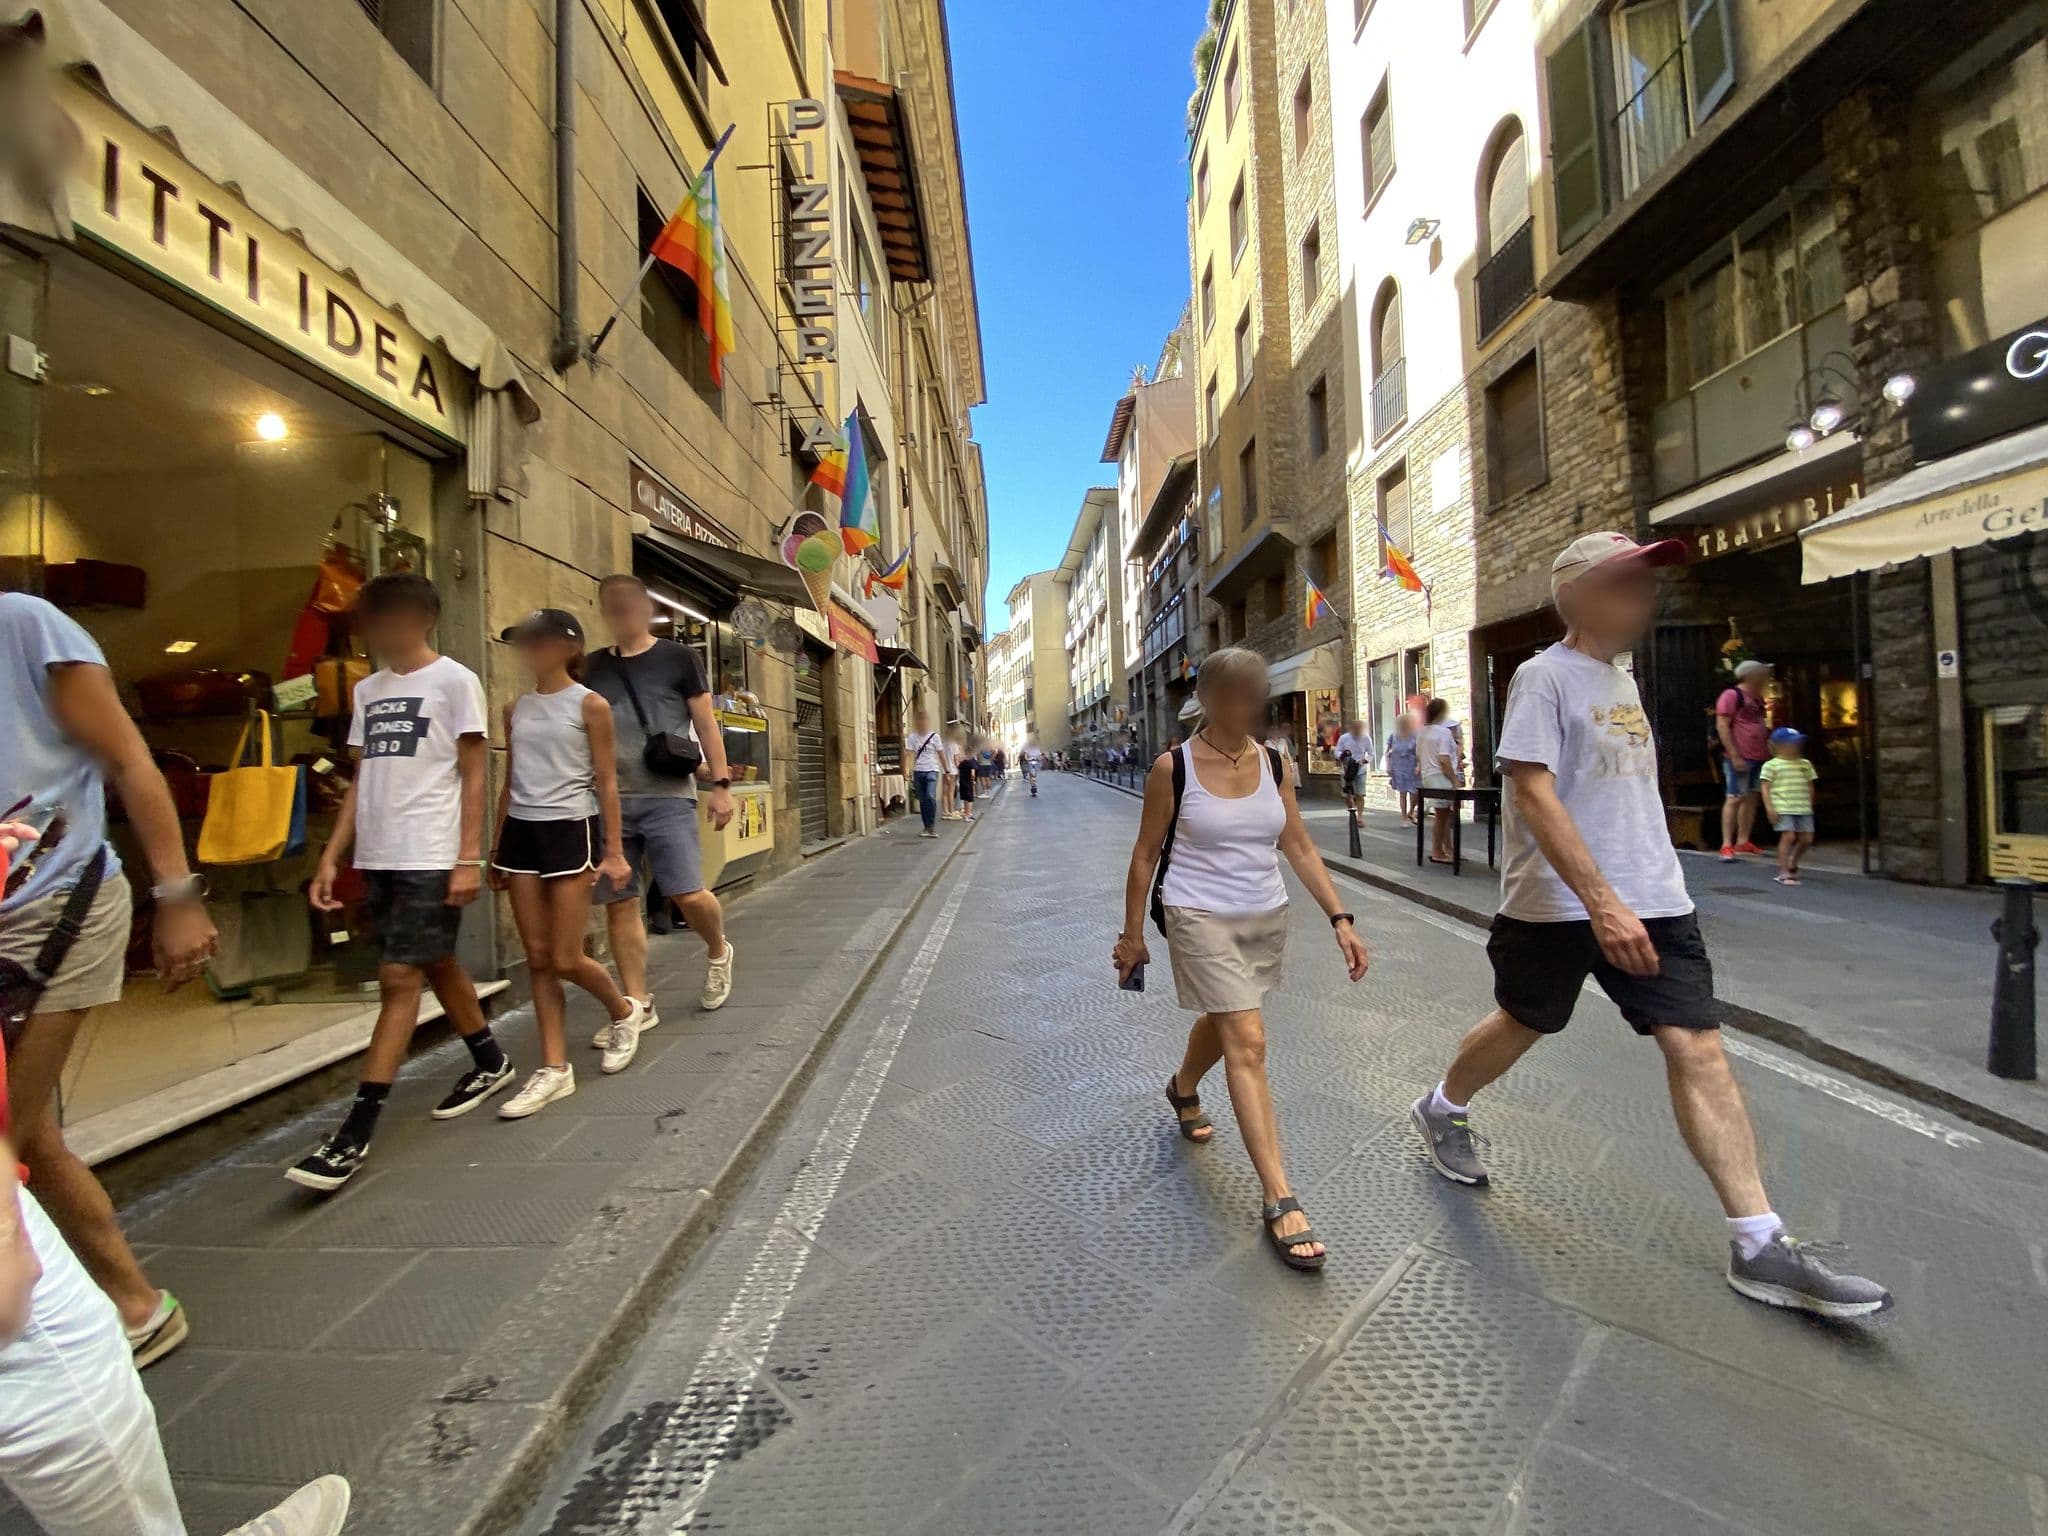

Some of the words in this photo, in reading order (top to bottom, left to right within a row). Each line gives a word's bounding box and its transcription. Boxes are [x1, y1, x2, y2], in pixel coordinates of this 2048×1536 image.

[103, 142, 259, 304] ITTI
[299, 271, 444, 416] IDEA
[787, 99, 844, 453] PIZZERIA
